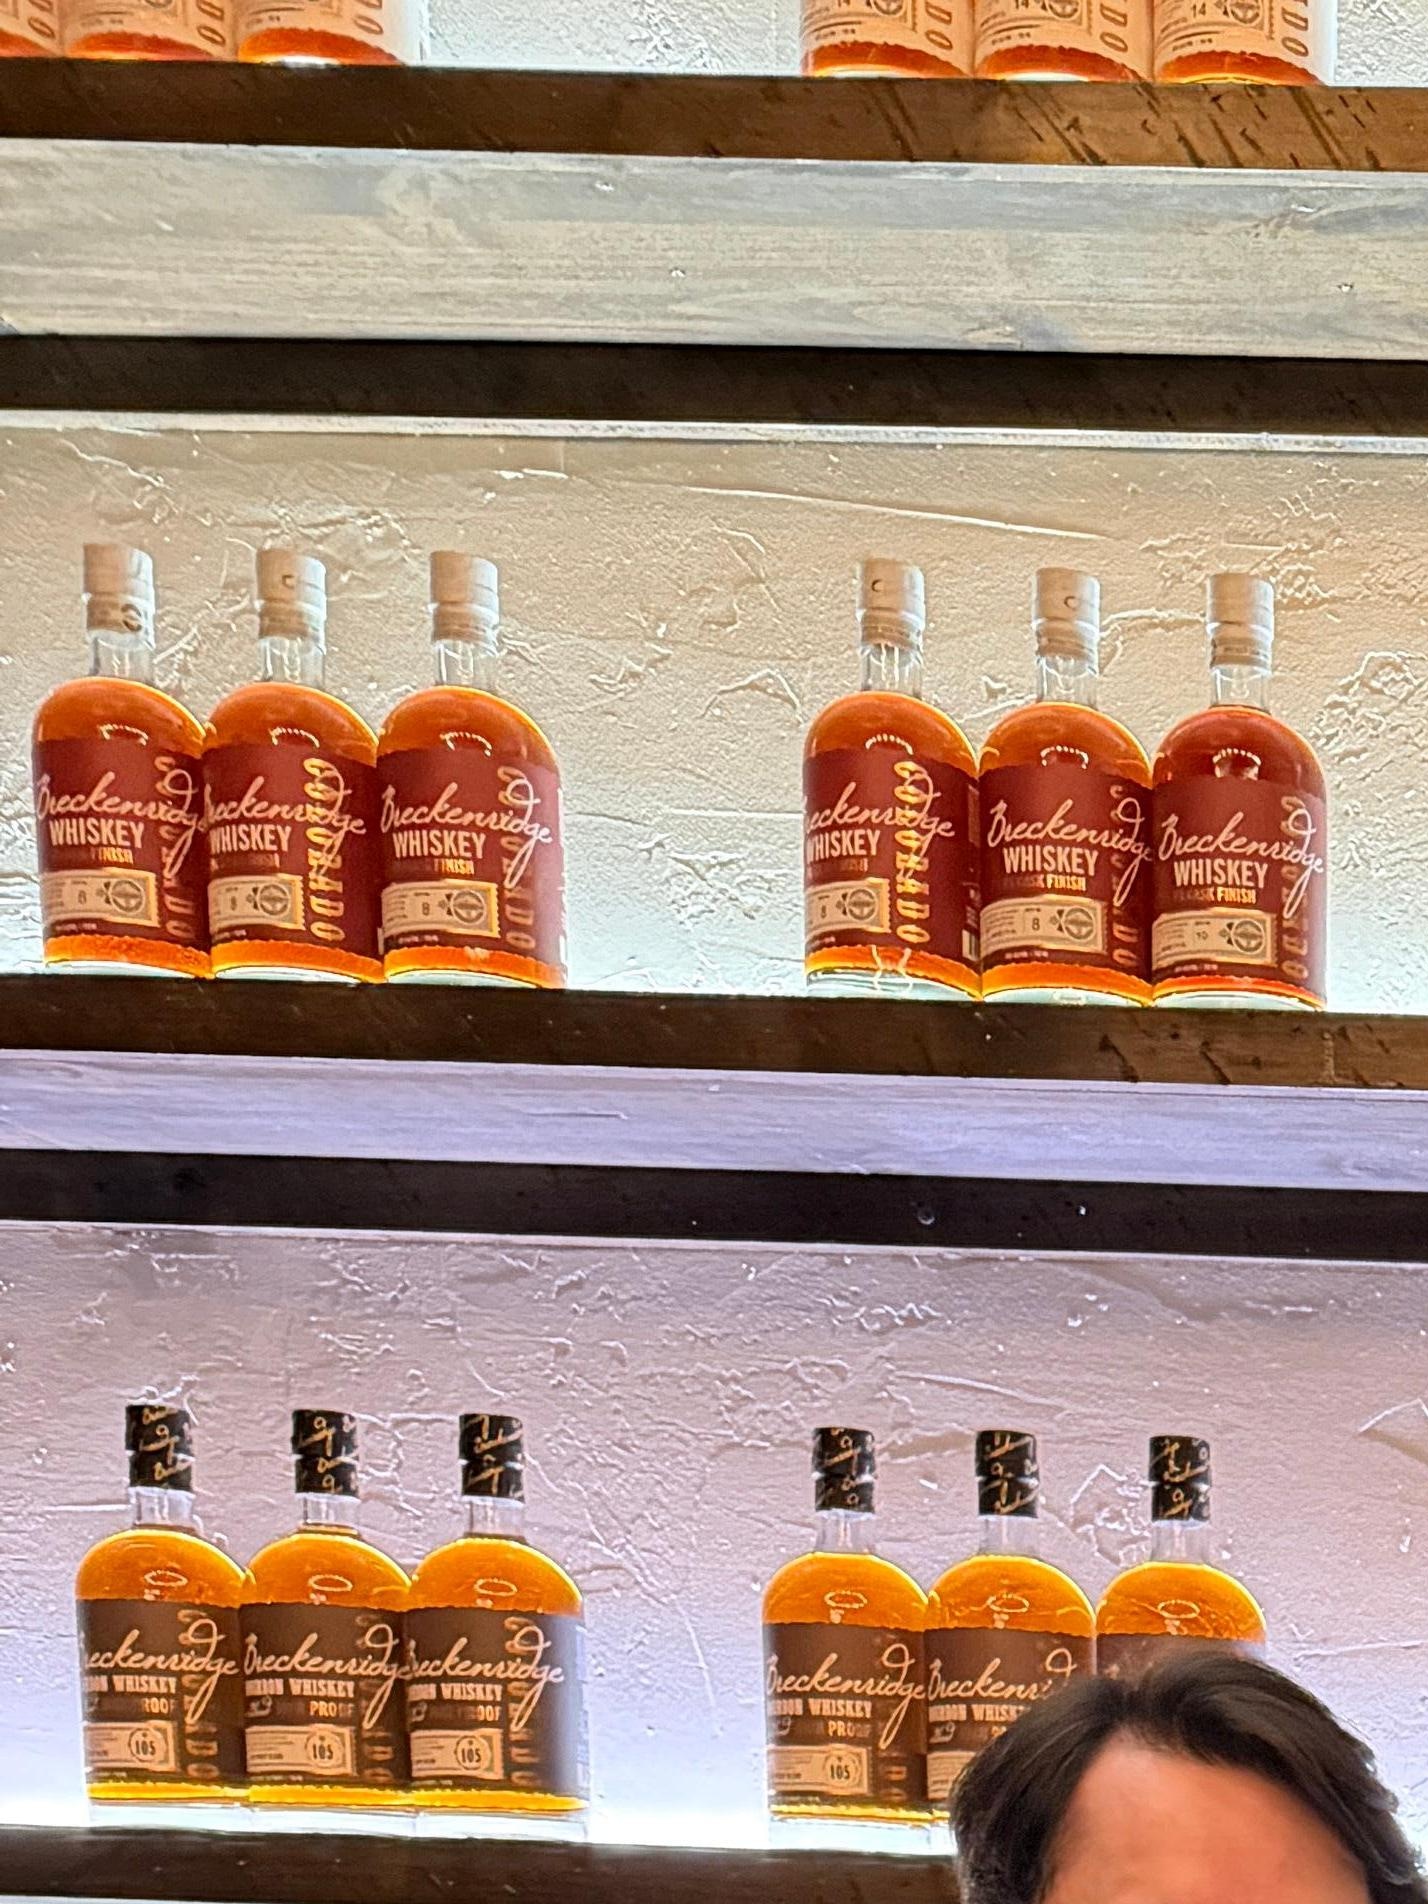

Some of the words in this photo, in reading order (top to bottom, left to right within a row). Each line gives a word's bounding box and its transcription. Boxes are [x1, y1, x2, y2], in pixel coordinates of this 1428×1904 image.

[49, 818, 145, 849] WHISKEY
[210, 825, 292, 852] WHISKEY
[393, 829, 487, 859] WHISKEY
[1003, 845, 1099, 877] WHISKEY
[1159, 808, 1325, 919] Breckenridge
[1173, 858, 1269, 889] WHISKEY
[1217, 887, 1257, 905] FINISH
[113, 1675, 176, 1694] WHISKEY
[289, 1679, 355, 1698] WHISKEY
[441, 1682, 503, 1702] WHISKEY
[809, 1700, 872, 1719] WHISKEY
[135, 1740, 155, 1756] 105
[313, 1743, 334, 1760] 105
[461, 1747, 482, 1762] 105
[829, 1764, 850, 1780] 105
